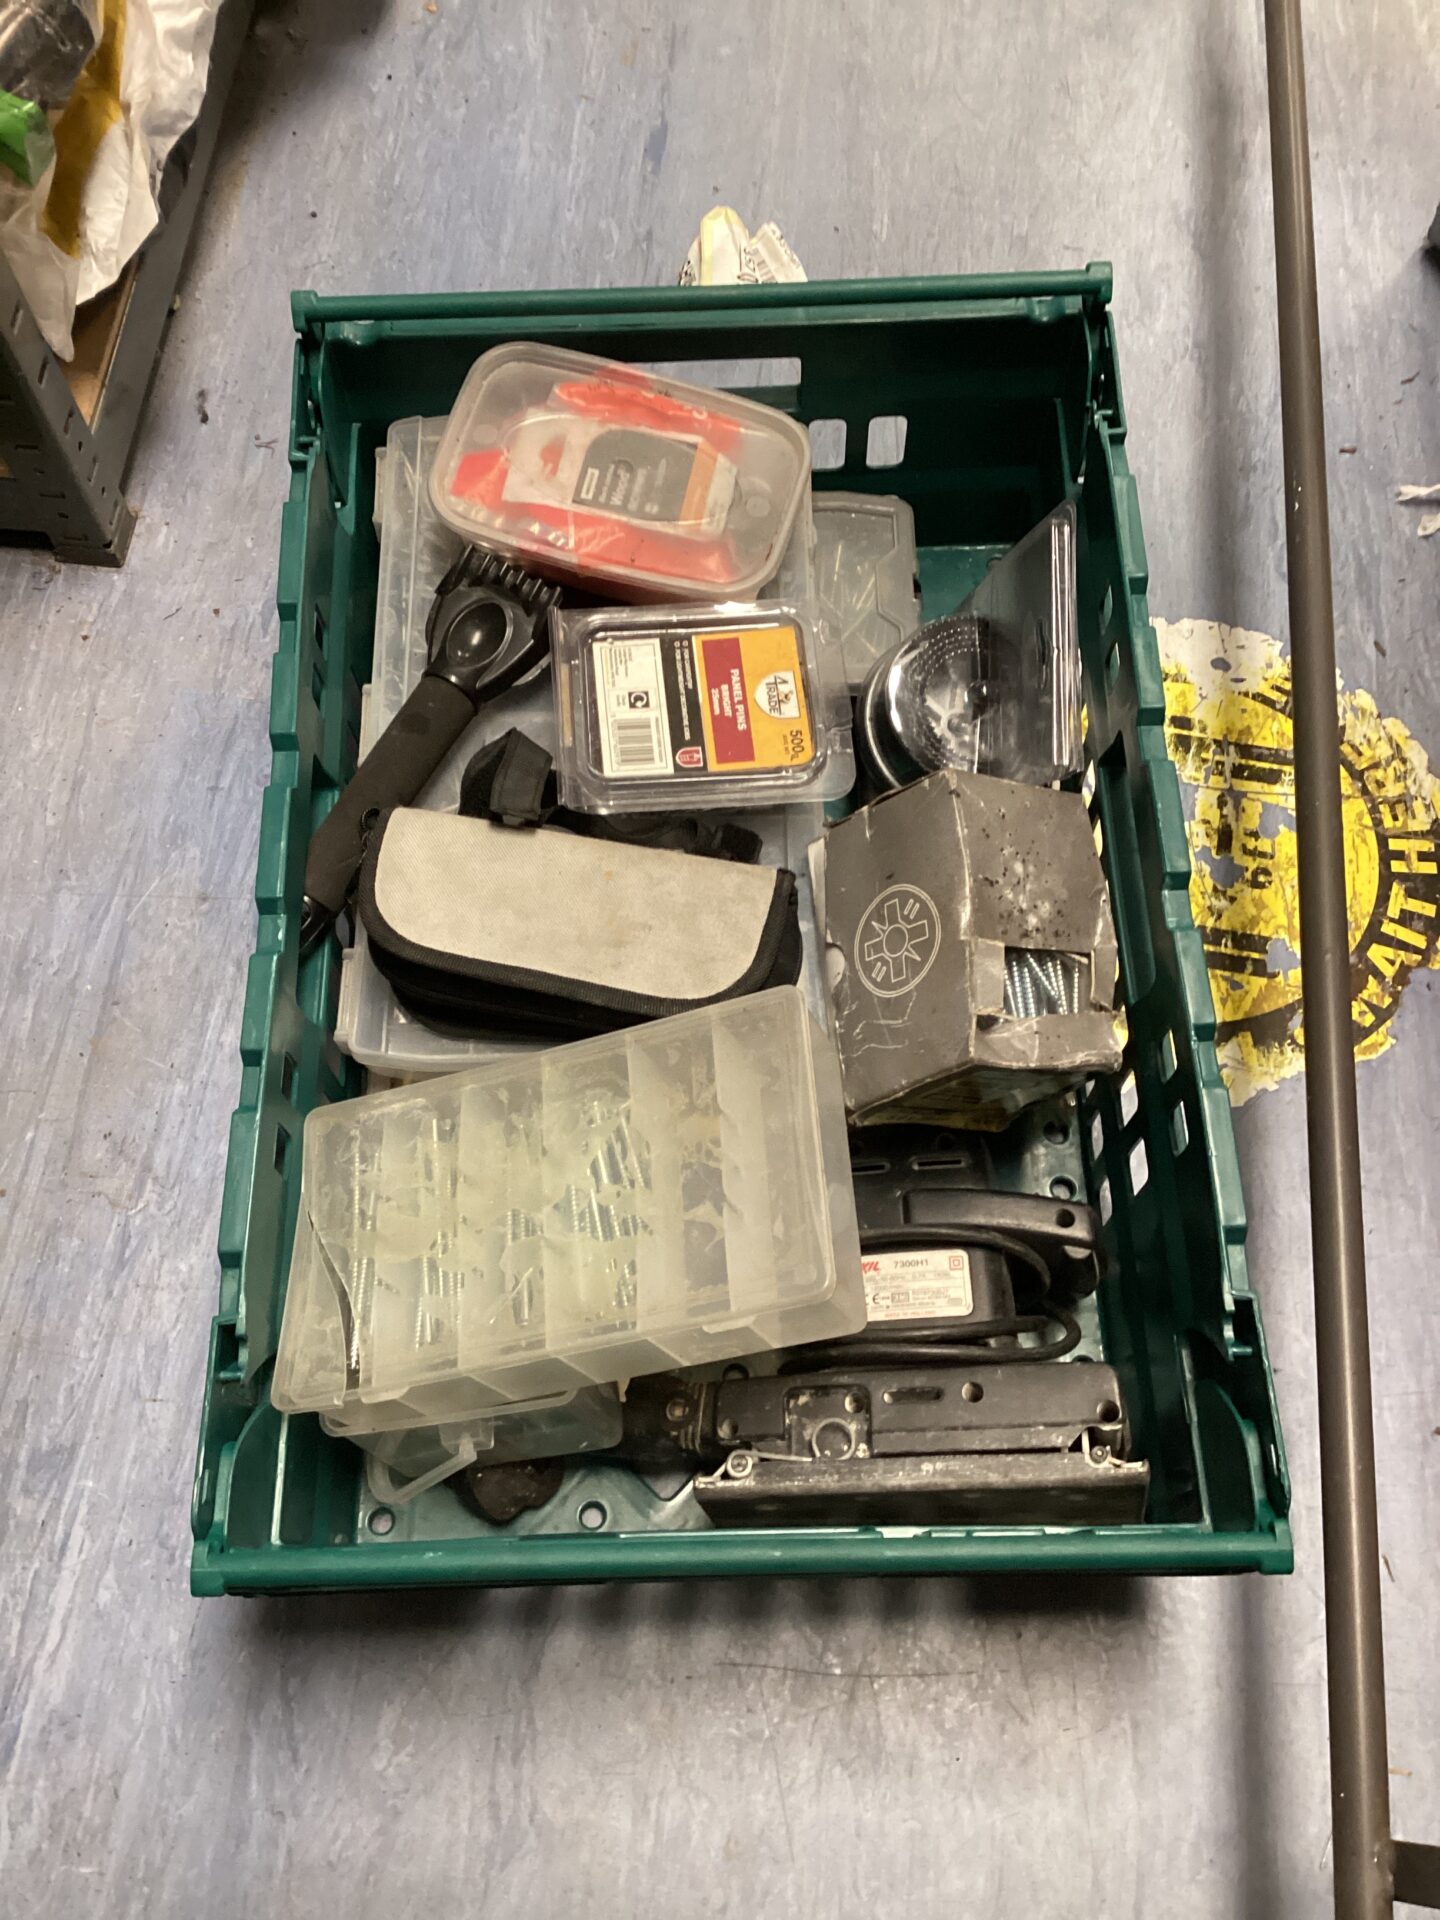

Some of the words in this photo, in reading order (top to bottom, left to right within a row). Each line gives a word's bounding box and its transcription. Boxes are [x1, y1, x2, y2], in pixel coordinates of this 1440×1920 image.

[721, 683, 732, 718] BRIGHT
[730, 668, 742, 704] PANEL
[711, 688, 721, 716] 25mm
[735, 704, 747, 731] PINS
